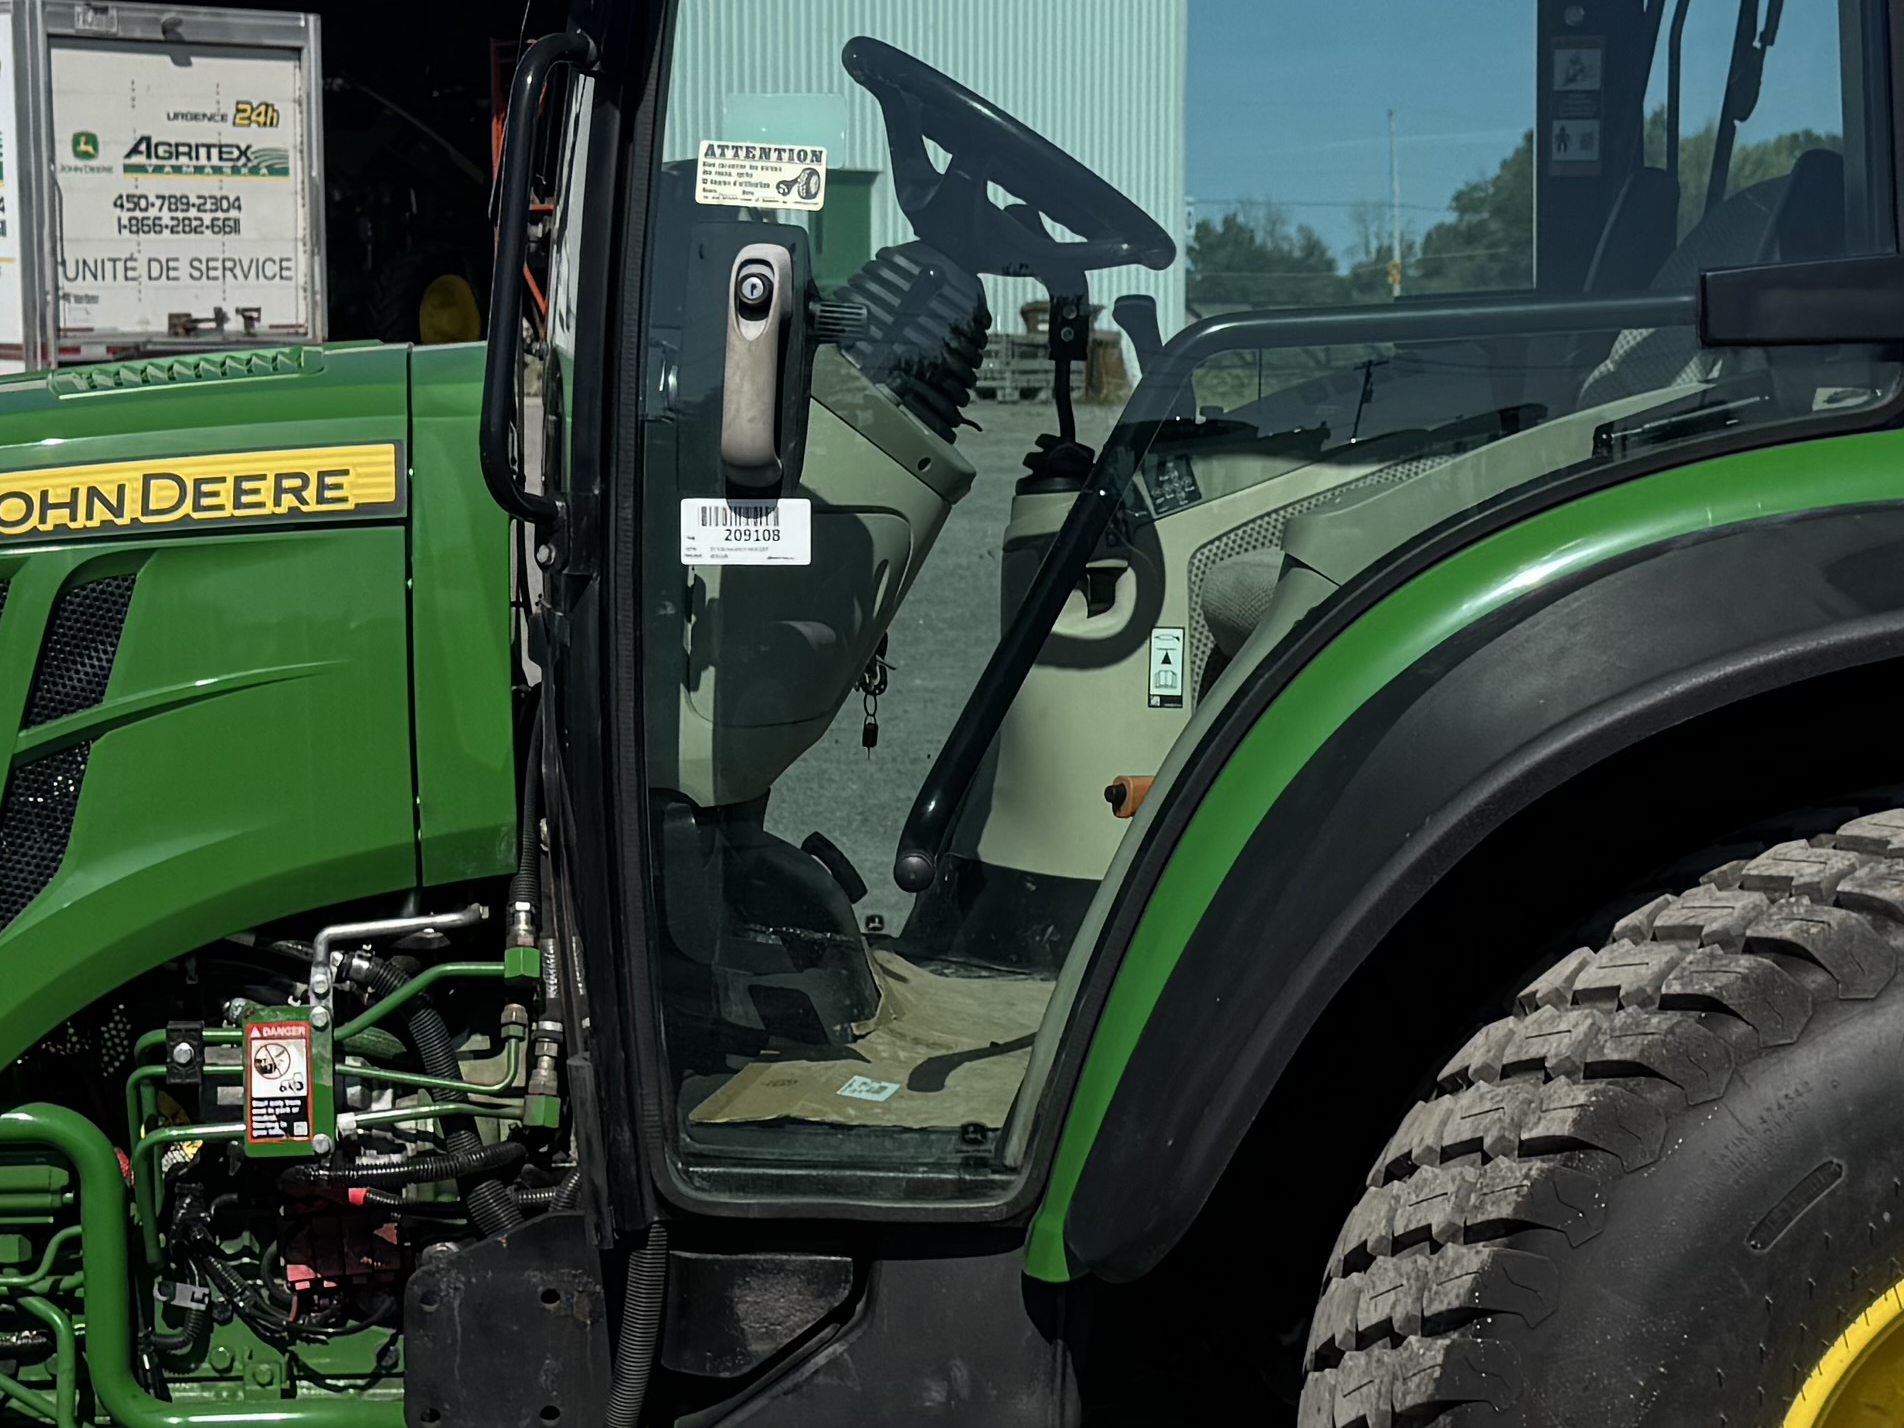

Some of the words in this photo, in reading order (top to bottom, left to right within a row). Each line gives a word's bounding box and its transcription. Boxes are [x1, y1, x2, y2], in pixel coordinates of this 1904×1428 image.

[167, 111, 228, 122] URGENCE
[233, 100, 280, 127] 24h
[124, 136, 253, 162] AGRITEX
[704, 143, 823, 164] ATTENTION
[114, 195, 242, 213] 450-789-2304
[118, 217, 240, 235] 1-866-282-6611
[64, 252, 138, 282] UNITÉ
[148, 258, 180, 281] DE
[189, 257, 293, 281] SERVICE
[141, 468, 351, 518] DEERE
[724, 528, 781, 542] 209108
[263, 1026, 306, 1036] DANGER
